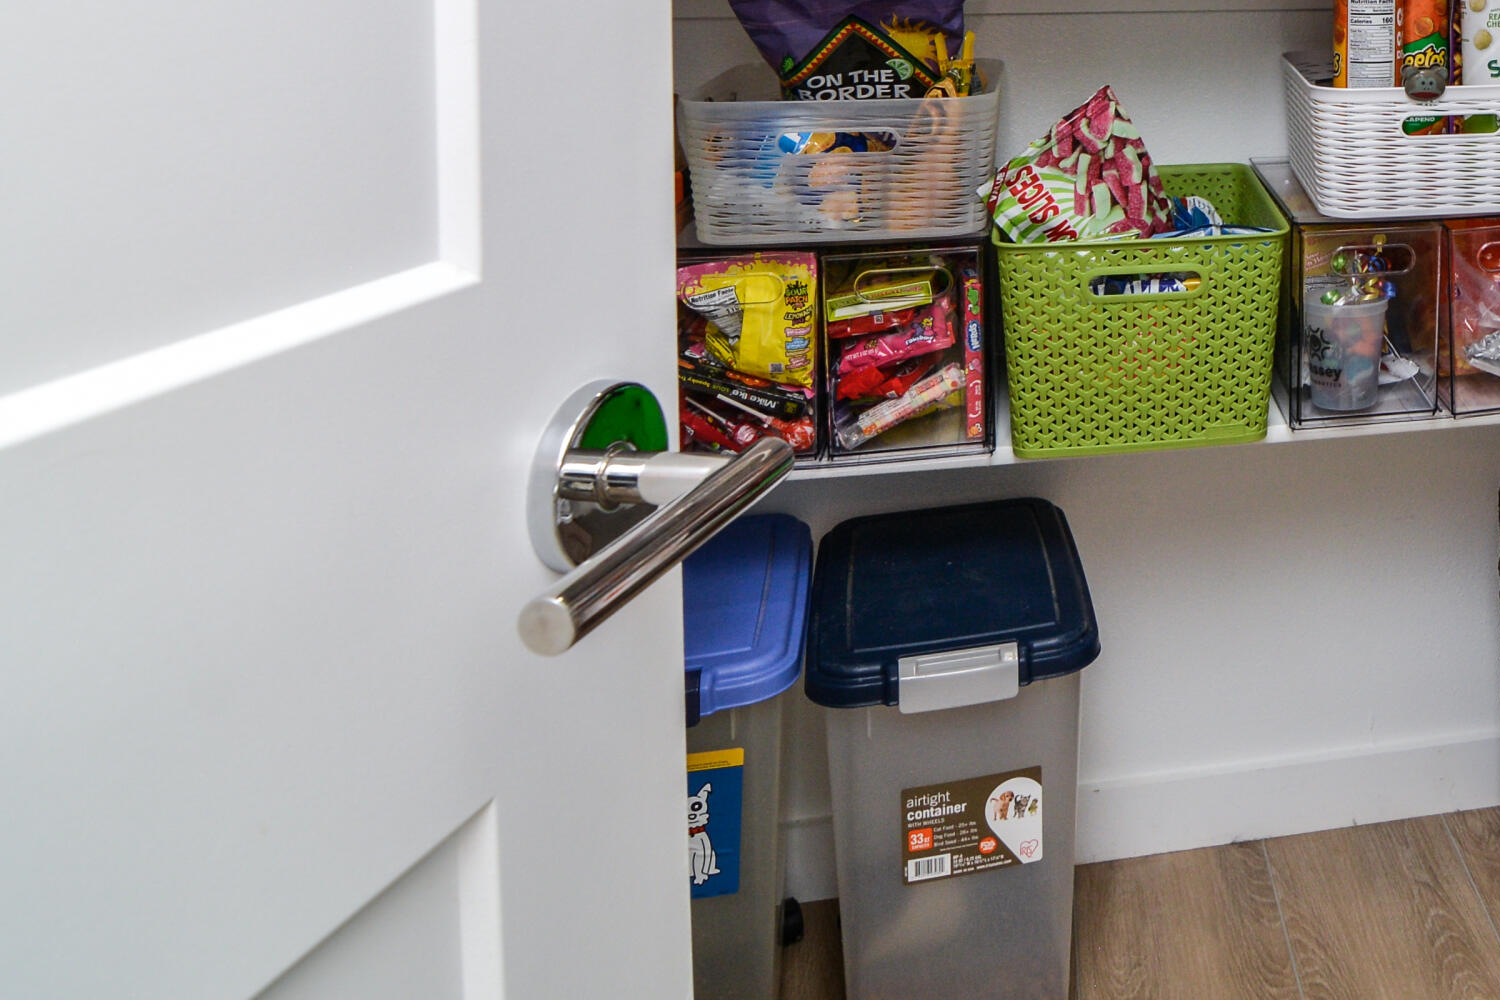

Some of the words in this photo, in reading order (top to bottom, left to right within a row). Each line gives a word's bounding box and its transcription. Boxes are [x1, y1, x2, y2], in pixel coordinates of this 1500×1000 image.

[1382, 16, 1394, 24] 160
[806, 72, 843, 90] ON
[848, 69, 894, 85] THE
[798, 84, 911, 100] BORDER
[1004, 164, 1060, 226] SLICES
[690, 291, 718, 304] Nutrition
[718, 287, 735, 297] Facts
[784, 294, 809, 304] PATCH
[785, 286, 808, 297] SOUR
[730, 388, 748, 402] Ike
[749, 394, 777, 409] Mike
[906, 791, 951, 809] airtight
[907, 802, 967, 821] container
[922, 818, 945, 827] WHEELS
[910, 832, 924, 845] 33
